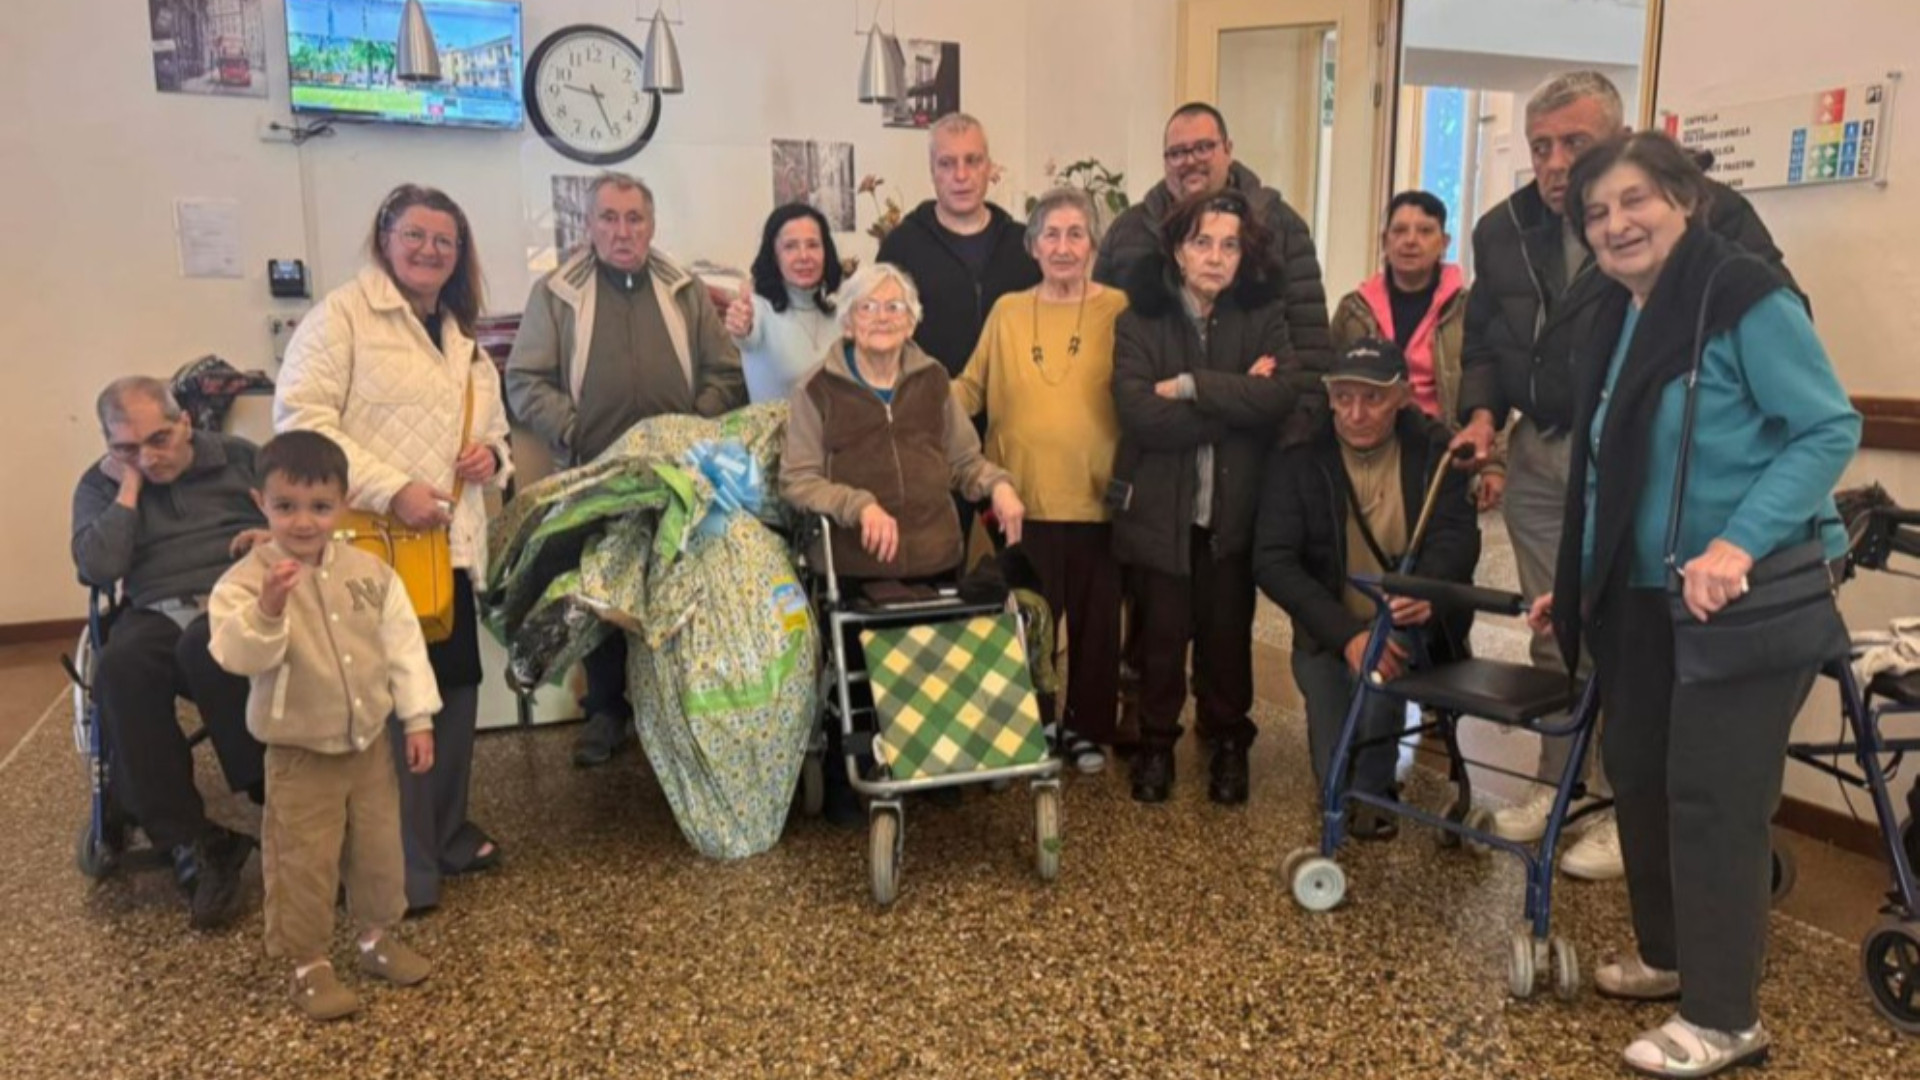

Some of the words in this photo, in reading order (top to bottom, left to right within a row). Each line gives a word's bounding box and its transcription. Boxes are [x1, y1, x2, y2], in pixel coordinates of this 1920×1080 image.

[570, 52, 582, 66] 11
[586, 47, 602, 63] 12
[556, 67, 572, 81] 10
[622, 69, 632, 84] 2
[549, 84, 560, 98] 9
[631, 91, 640, 105] 3
[556, 104, 567, 118] 8
[624, 109, 632, 122] 4
[573, 119, 582, 134] 7
[590, 125, 602, 140] 6
[612, 123, 622, 139] 5
